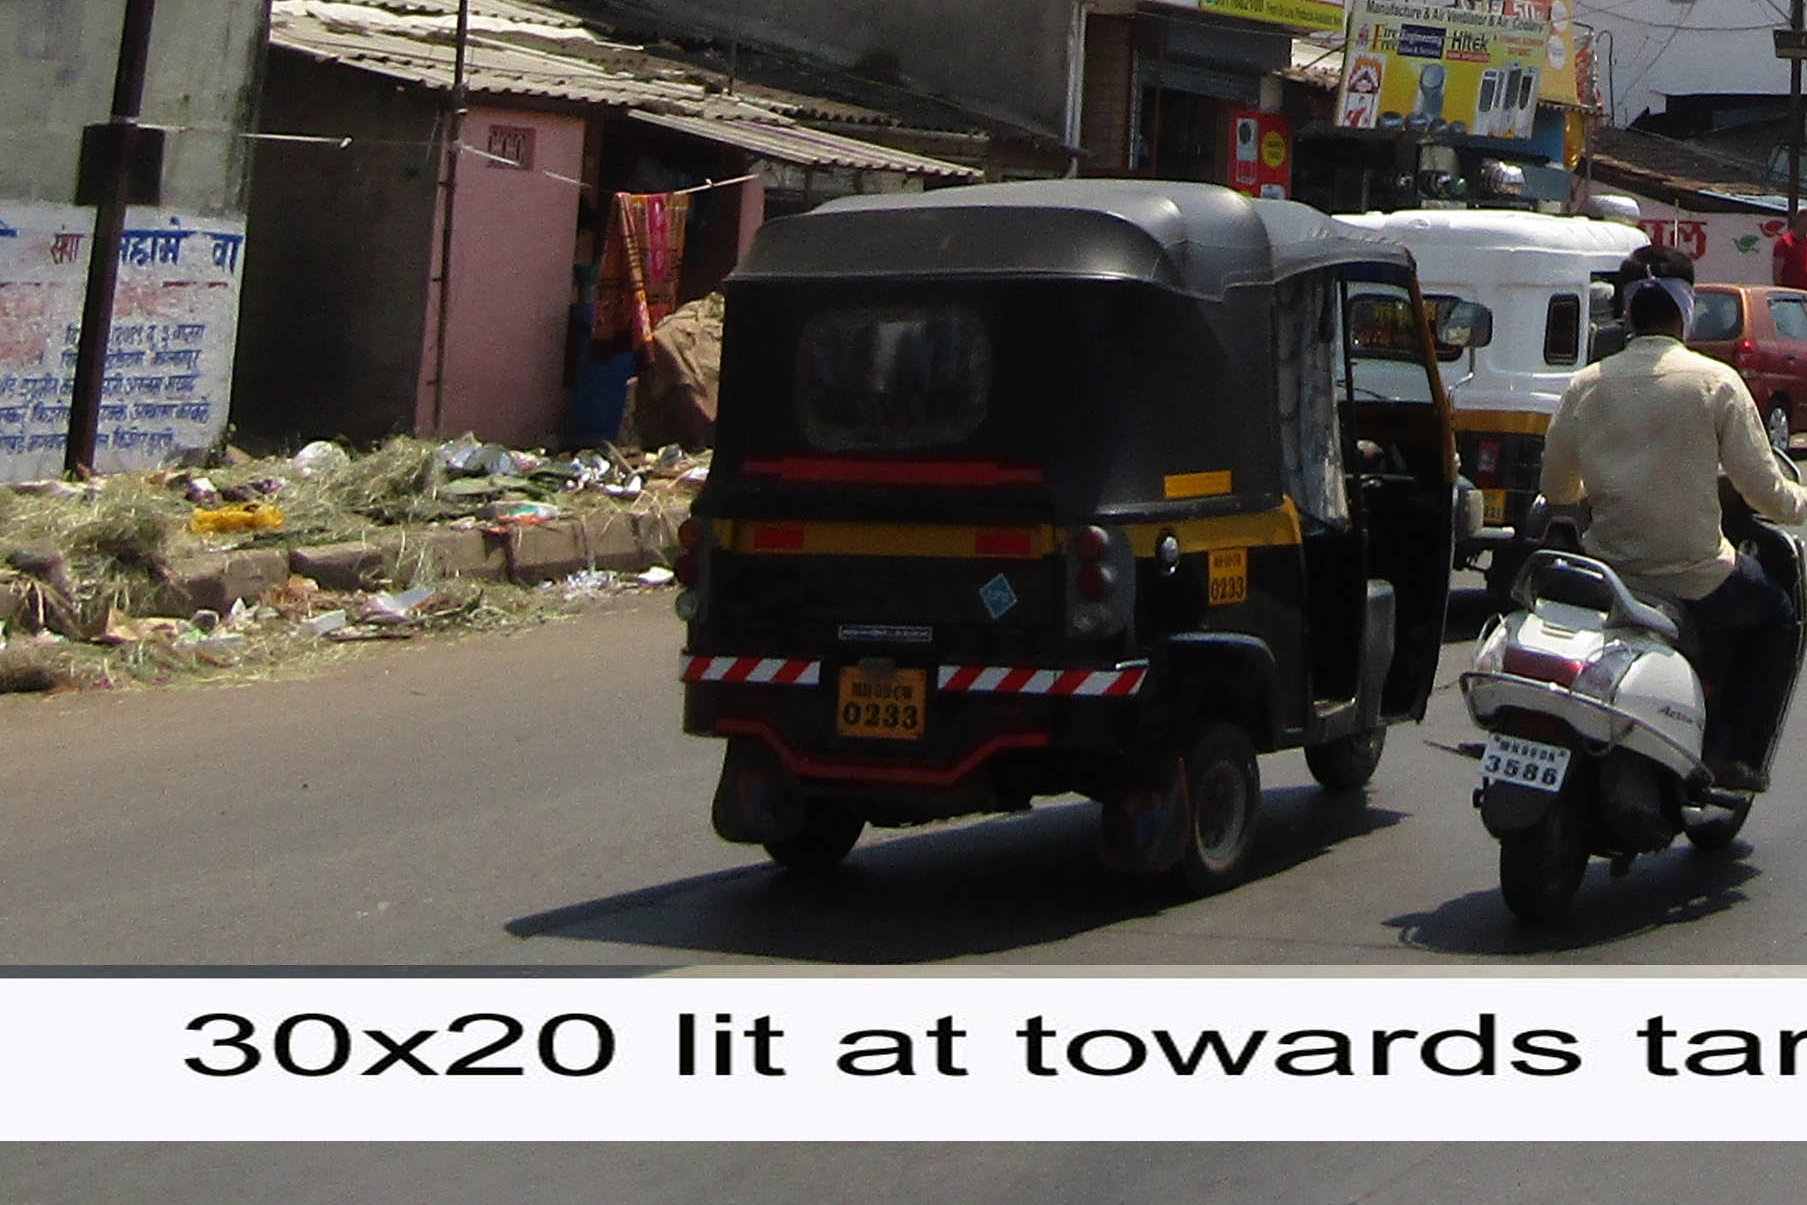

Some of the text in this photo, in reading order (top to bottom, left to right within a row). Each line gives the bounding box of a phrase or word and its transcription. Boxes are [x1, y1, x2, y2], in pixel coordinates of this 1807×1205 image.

[1451, 29, 1490, 53] Hitek
[842, 700, 918, 730] 0233
[1484, 753, 1558, 787] 3586
